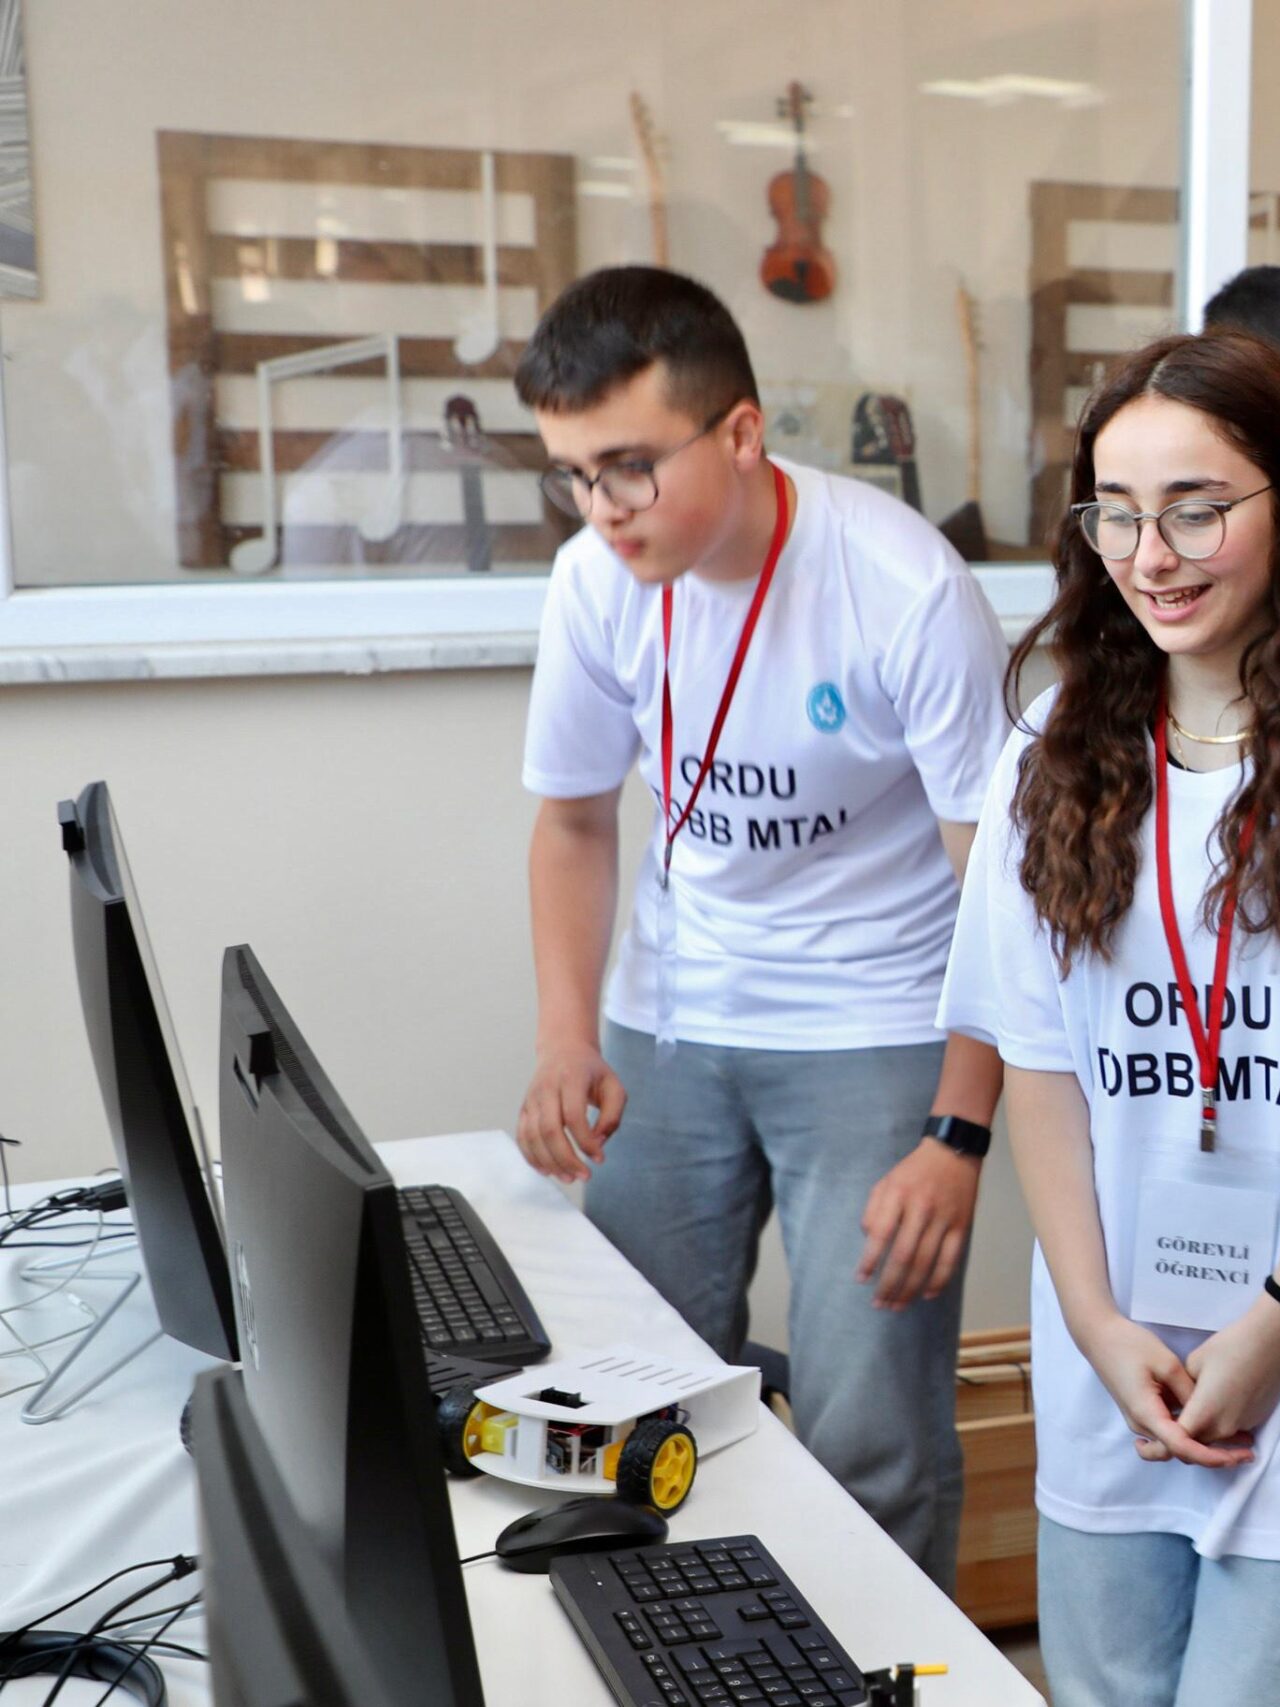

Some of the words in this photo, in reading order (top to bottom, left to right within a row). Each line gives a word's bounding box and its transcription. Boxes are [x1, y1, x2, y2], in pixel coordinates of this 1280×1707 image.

[680, 756, 797, 801] ORDU
[1125, 981, 1271, 1031] ORDU
[1157, 1235, 1250, 1261] GÖREVLİ
[1155, 1258, 1250, 1285] ÖĞRENCİ
